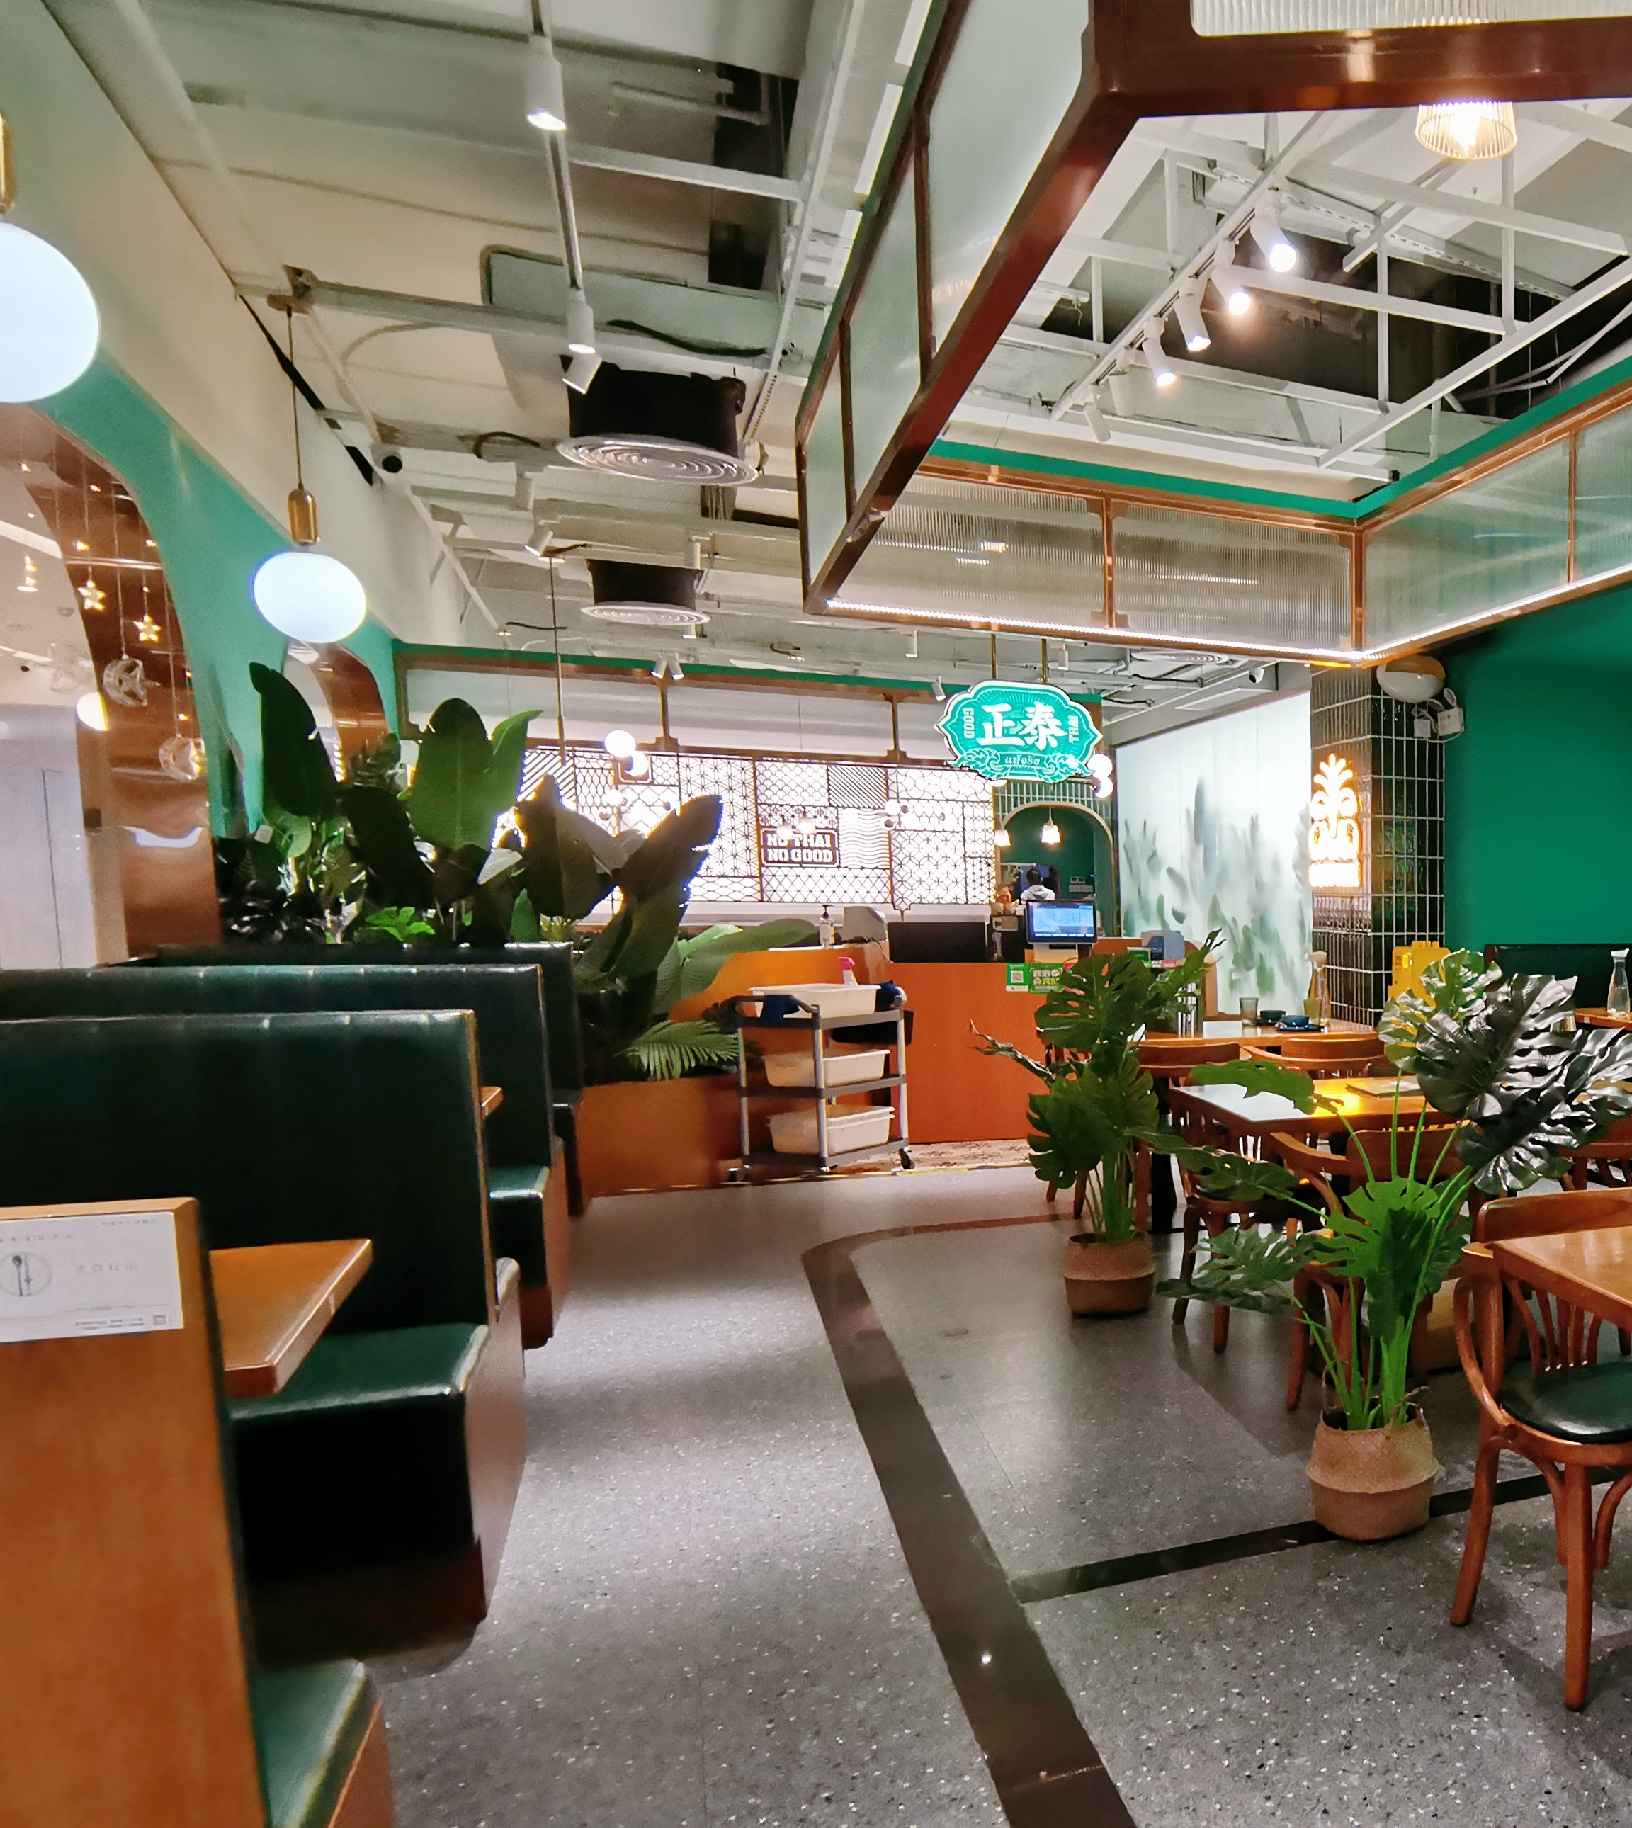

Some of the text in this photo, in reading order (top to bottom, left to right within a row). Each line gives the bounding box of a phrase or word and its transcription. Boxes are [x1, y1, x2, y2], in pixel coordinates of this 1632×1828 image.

[963, 708, 975, 738] GOOD
[976, 701, 1067, 750] 正泰
[1067, 715, 1079, 743] THAI
[792, 834, 831, 847] THAI
[767, 849, 833, 862] NO GOOD
